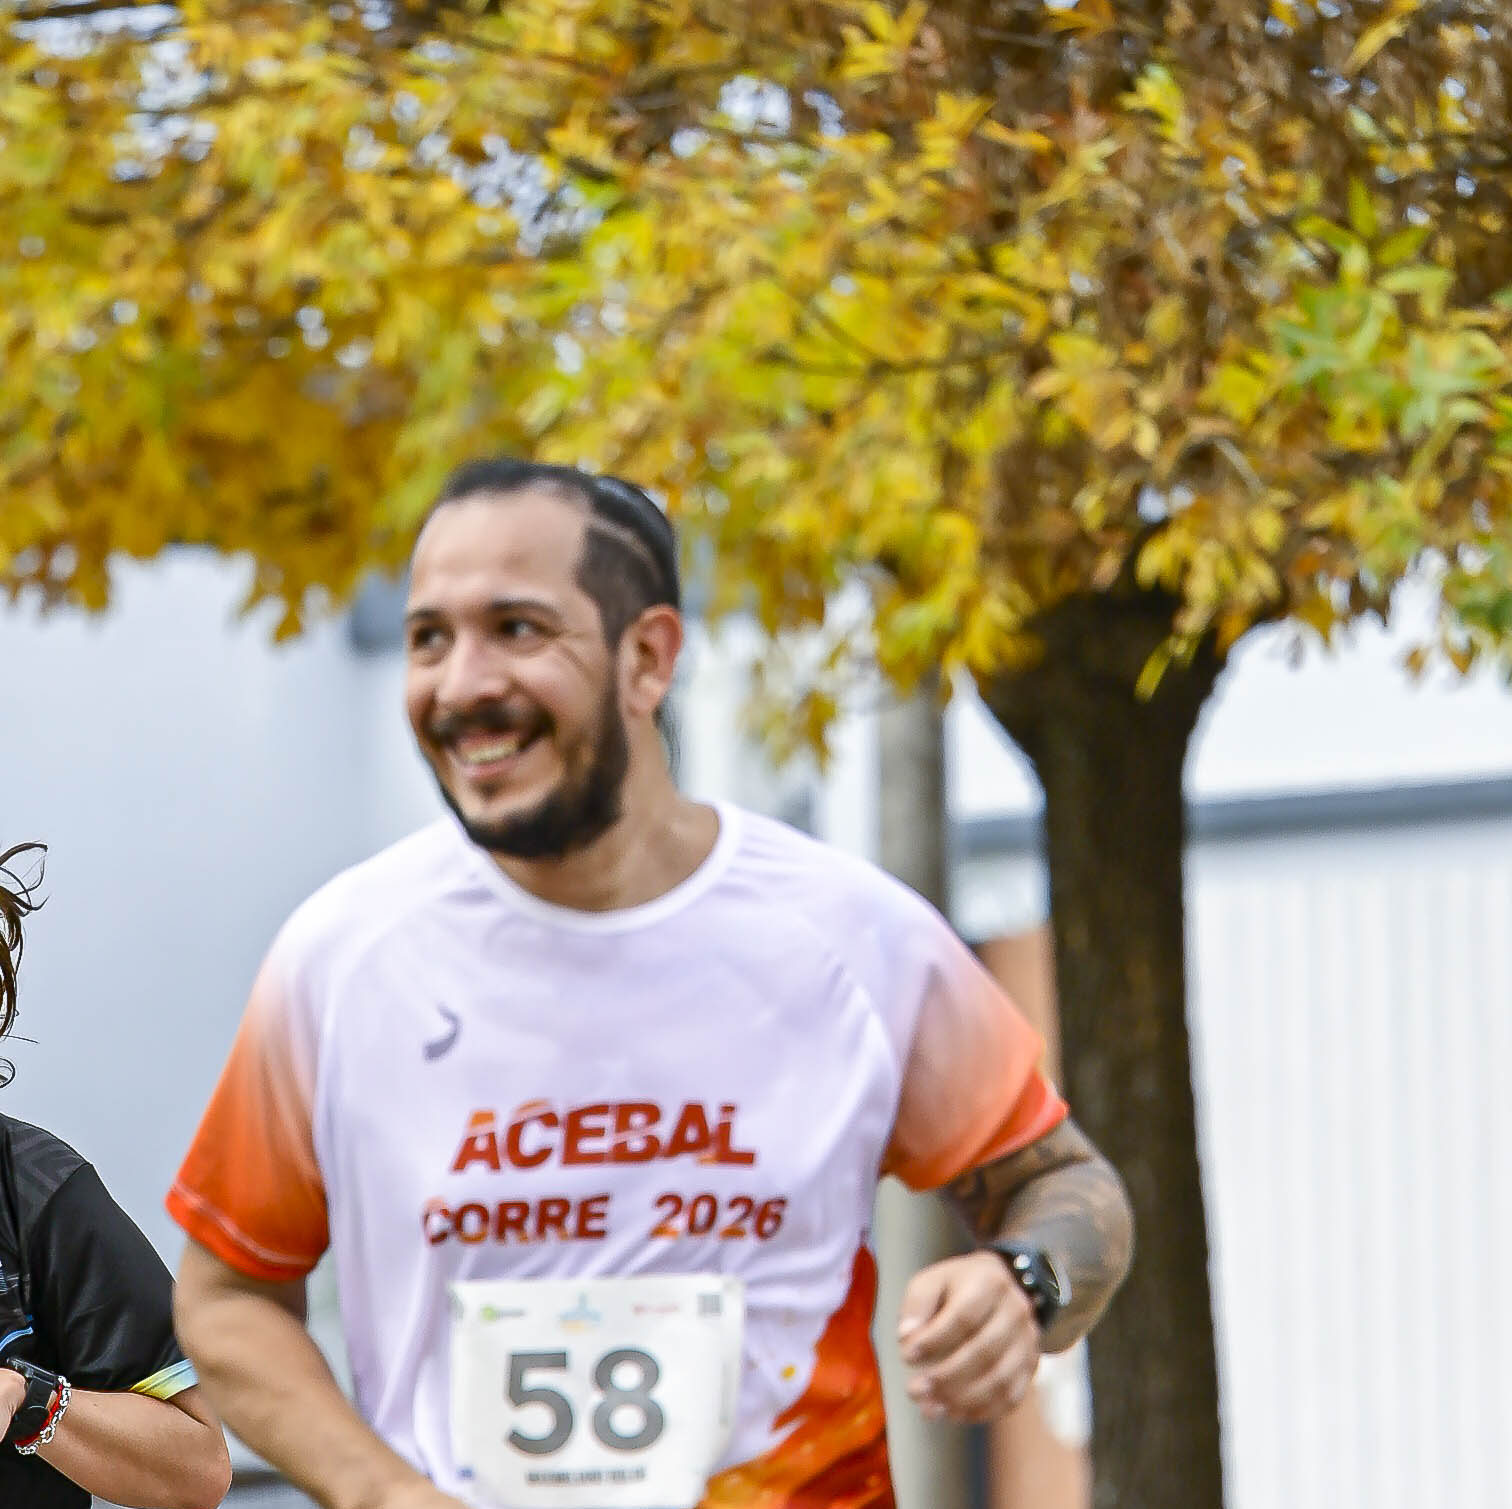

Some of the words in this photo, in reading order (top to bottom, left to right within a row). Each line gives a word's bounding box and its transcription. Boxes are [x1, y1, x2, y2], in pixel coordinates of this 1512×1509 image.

[452, 1099, 755, 1172] ACEBAL
[423, 1192, 611, 1245] CORRE
[650, 1192, 788, 1241] 2026
[507, 1349, 665, 1455] 58
